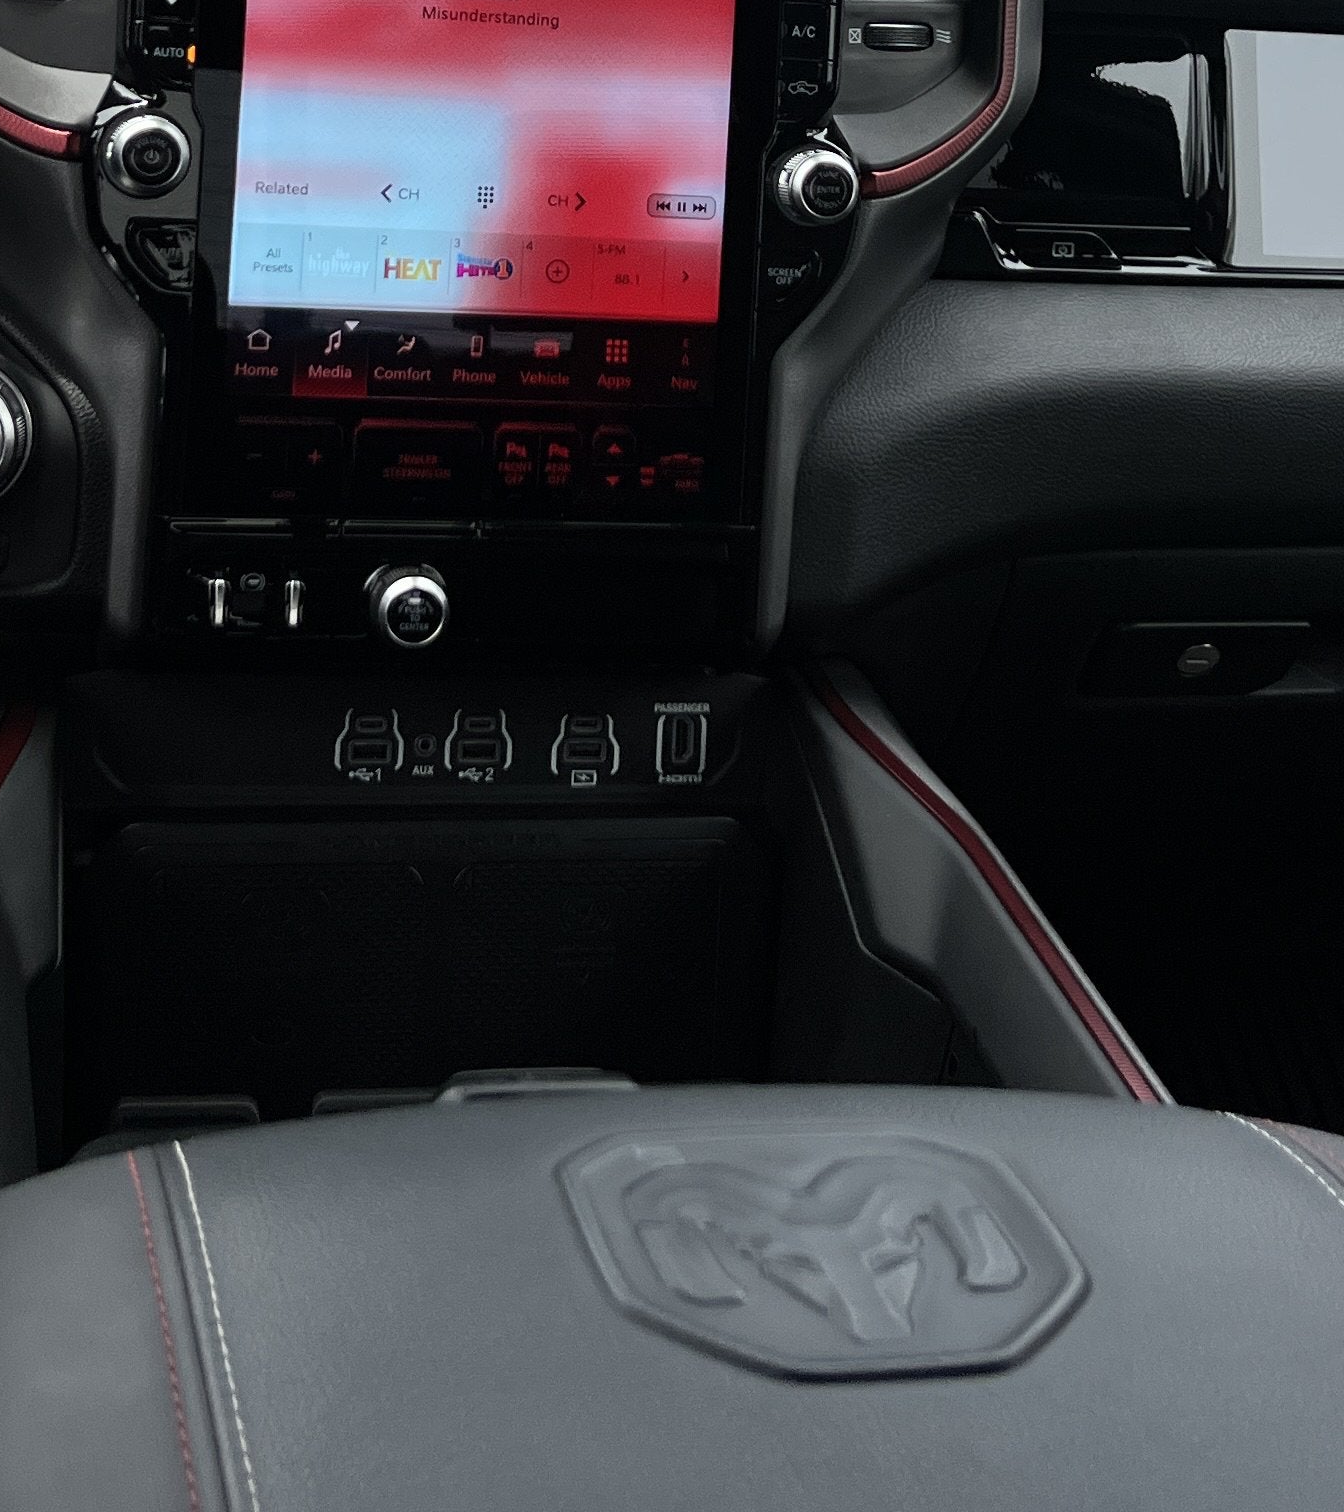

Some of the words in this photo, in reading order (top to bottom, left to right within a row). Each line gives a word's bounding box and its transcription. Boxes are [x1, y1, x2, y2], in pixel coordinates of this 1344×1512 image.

[421, 5, 561, 30] Misunderstanding
[791, 25, 817, 38] A/C
[153, 45, 185, 58] AUTO
[254, 180, 309, 196] Related
[398, 187, 421, 201] CH
[547, 194, 570, 208] CH
[380, 234, 389, 246] 2
[454, 238, 462, 248] 3
[526, 241, 534, 251] 4
[266, 247, 283, 260] All
[252, 261, 294, 274] Presets
[308, 254, 371, 278] highway
[383, 256, 443, 281] HEAT
[767, 267, 802, 278] SCREEN
[234, 362, 279, 378] Home
[308, 363, 353, 380] Media
[373, 365, 432, 383] Comfort
[452, 368, 497, 384] Phone
[520, 370, 570, 387] Vehicle
[596, 373, 632, 391] Apps
[412, 764, 434, 776] AUX
